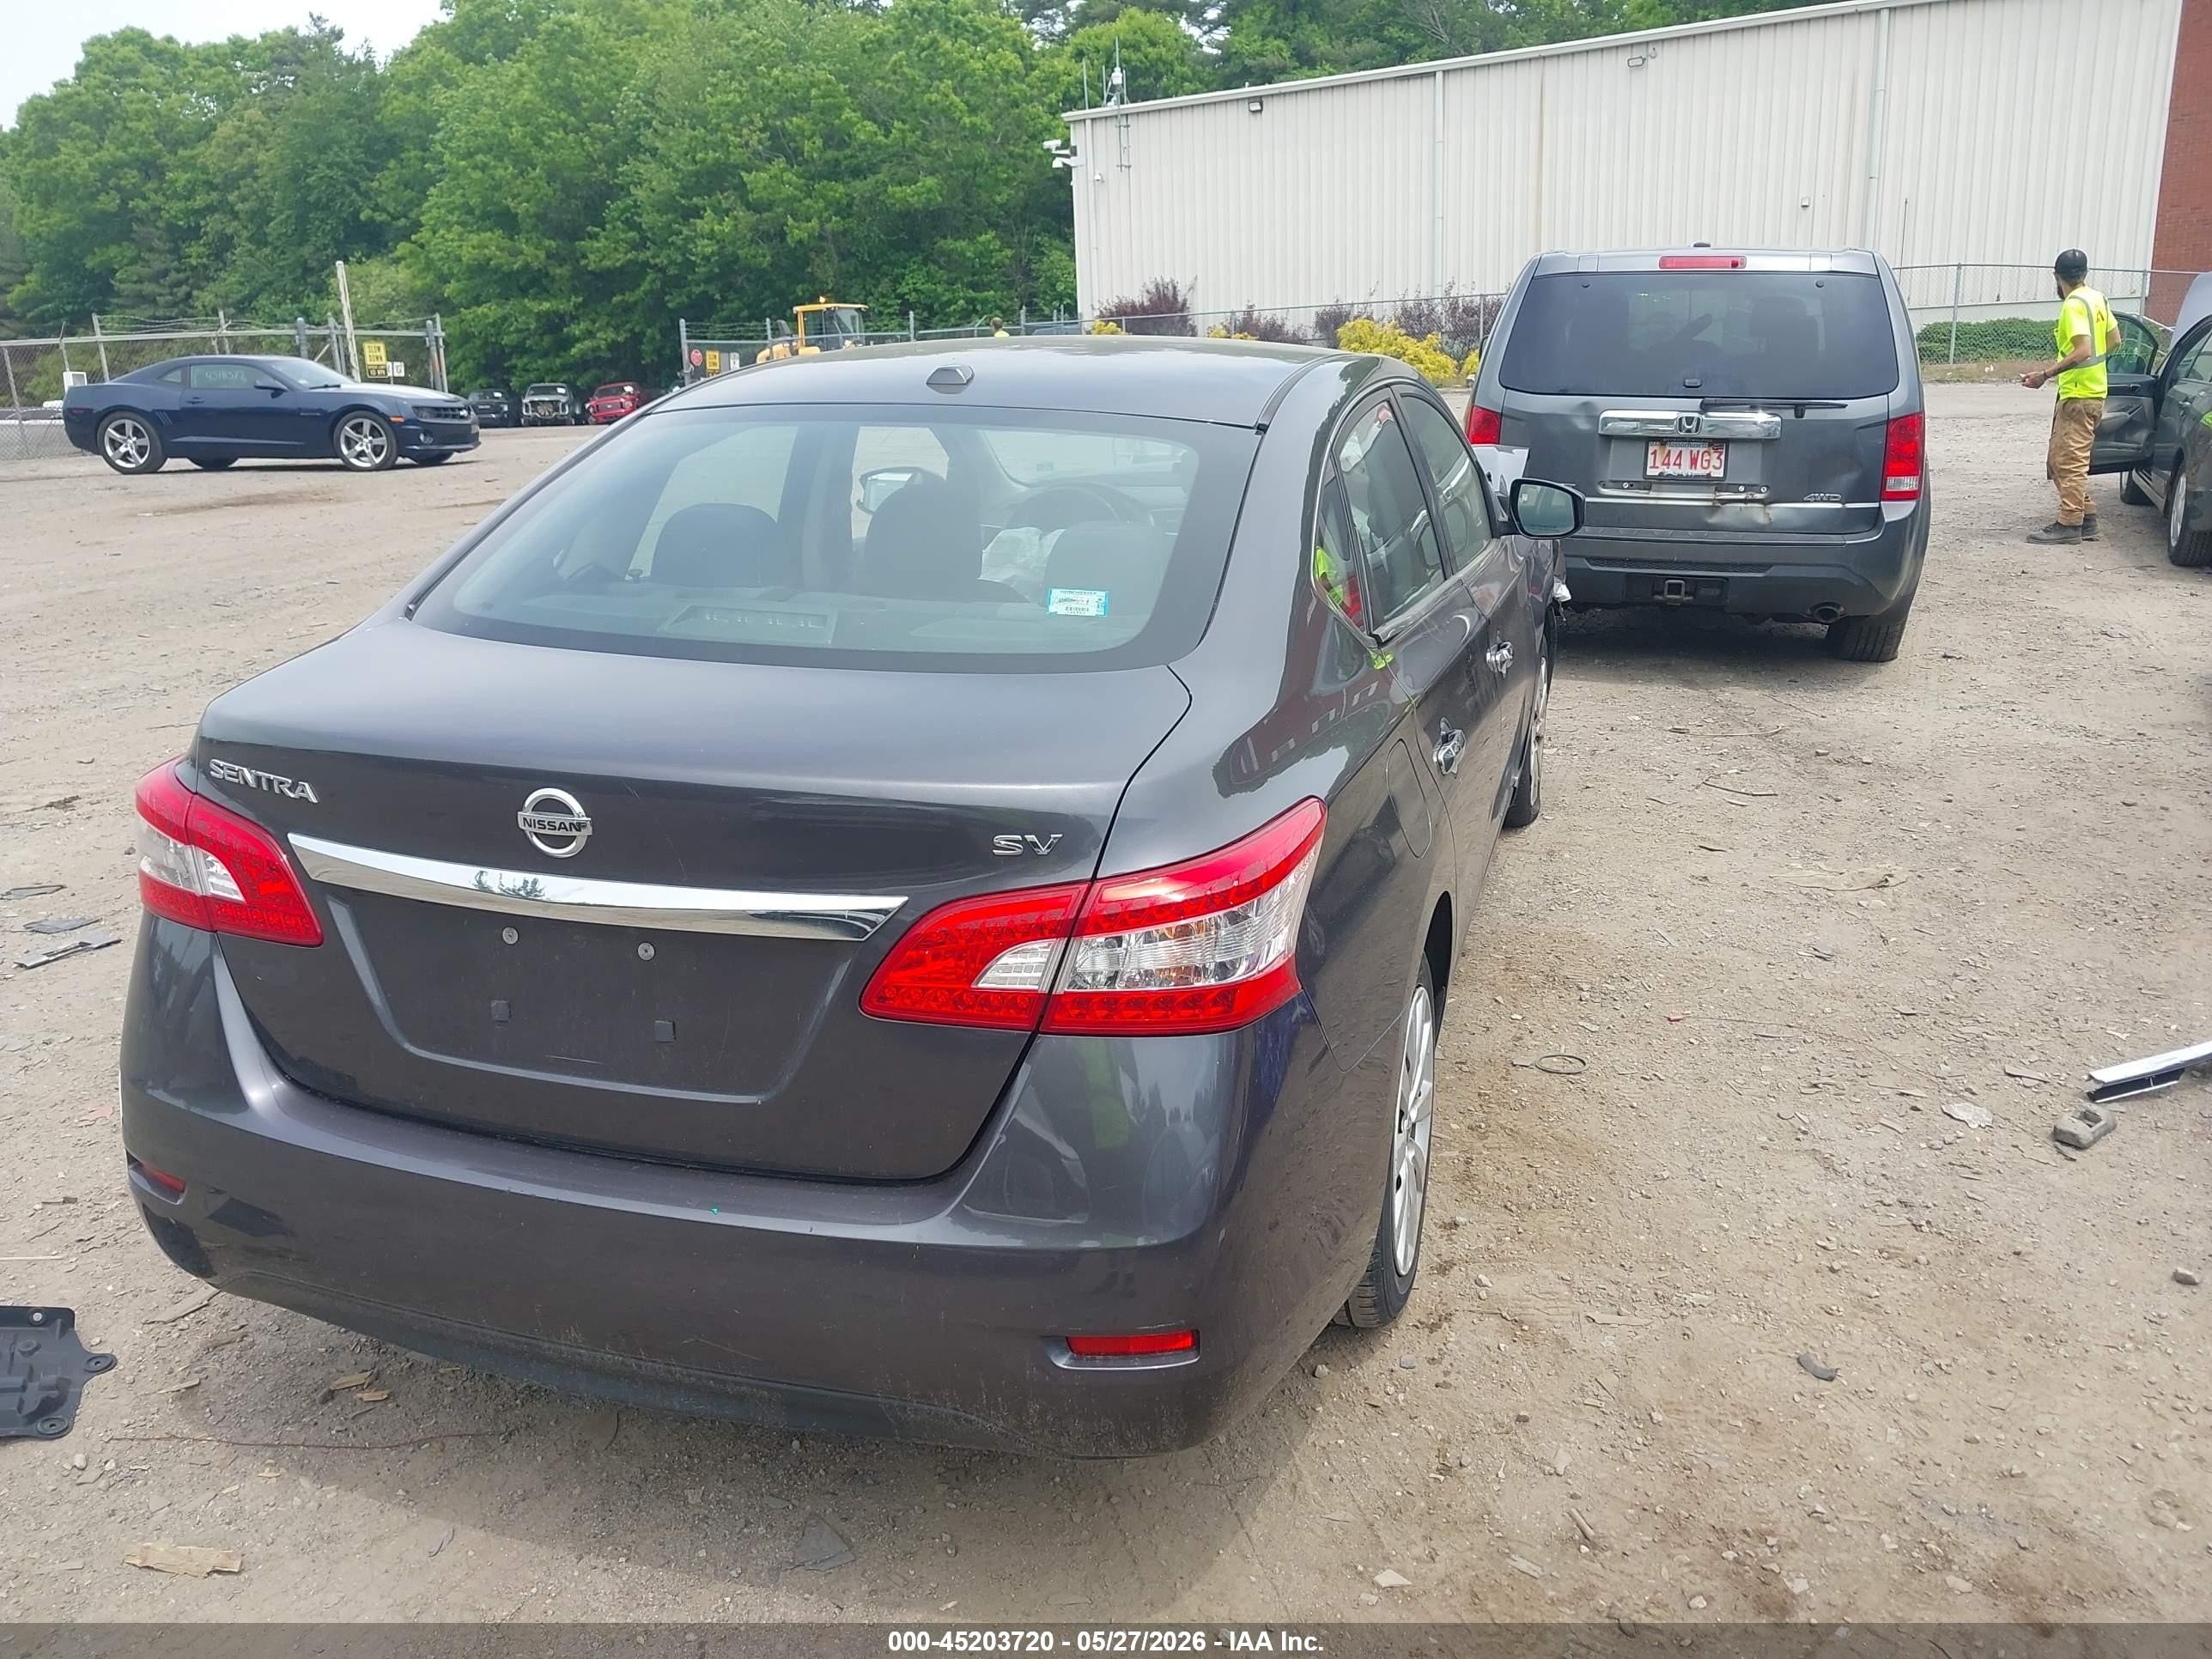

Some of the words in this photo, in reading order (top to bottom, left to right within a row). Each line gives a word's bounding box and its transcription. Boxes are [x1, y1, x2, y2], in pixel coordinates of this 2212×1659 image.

[1649, 449, 1683, 470] 144
[1689, 449, 1724, 471] WG3
[1803, 493, 1842, 502] 4WD
[209, 758, 319, 804] SENTRA
[521, 817, 589, 832] NISSAN
[992, 833, 1063, 856] SV
